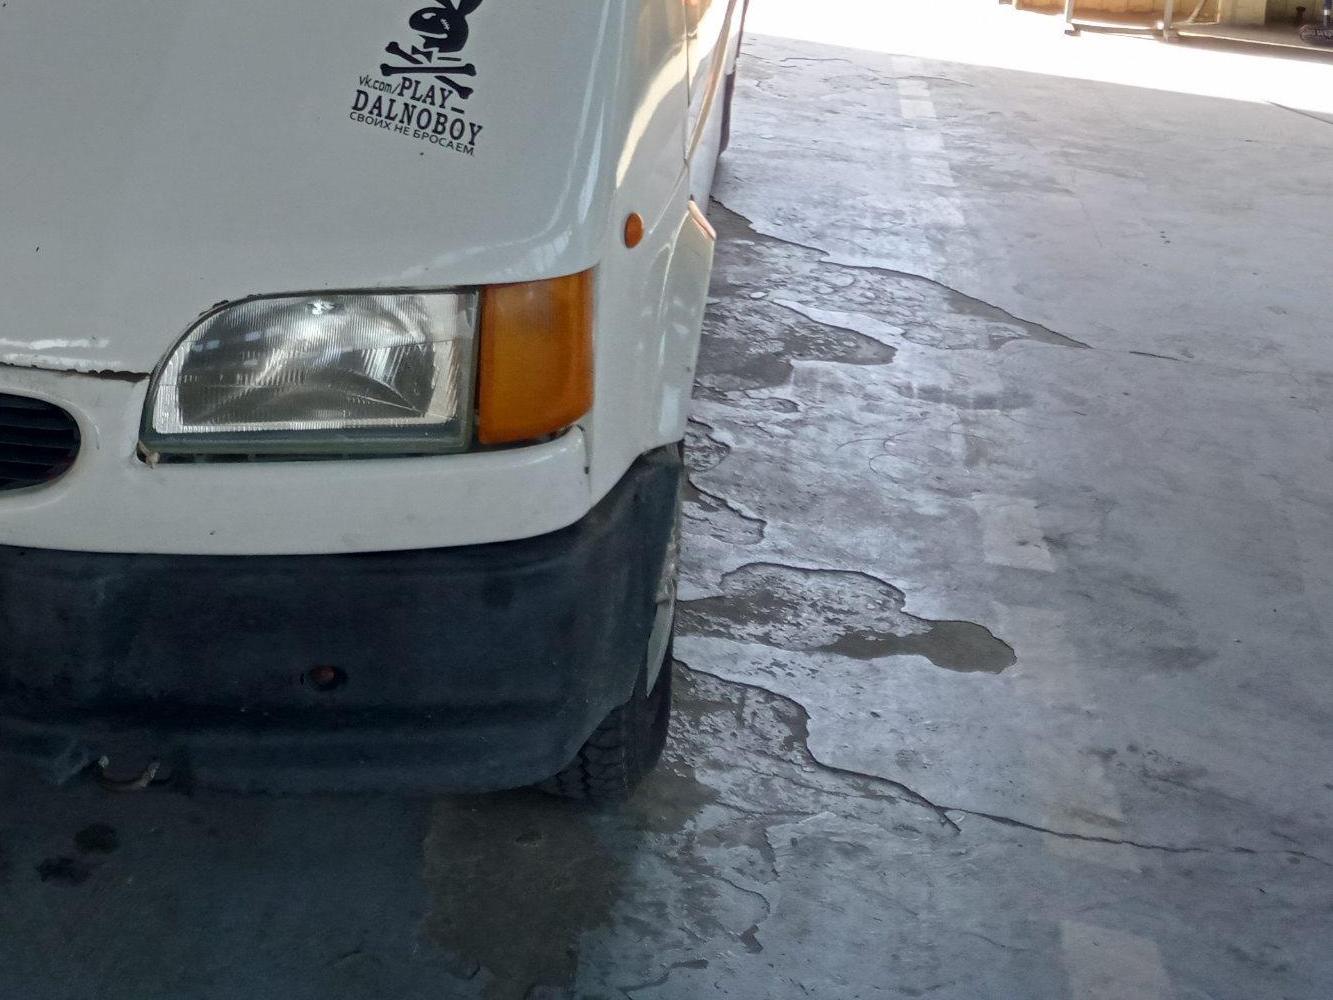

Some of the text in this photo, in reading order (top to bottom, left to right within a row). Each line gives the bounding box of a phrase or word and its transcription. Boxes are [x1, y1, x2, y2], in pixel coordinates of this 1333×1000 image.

[349, 111, 391, 130] СВОИХ
[394, 123, 410, 136] НЕ
[351, 89, 483, 146] DALNOBOY
